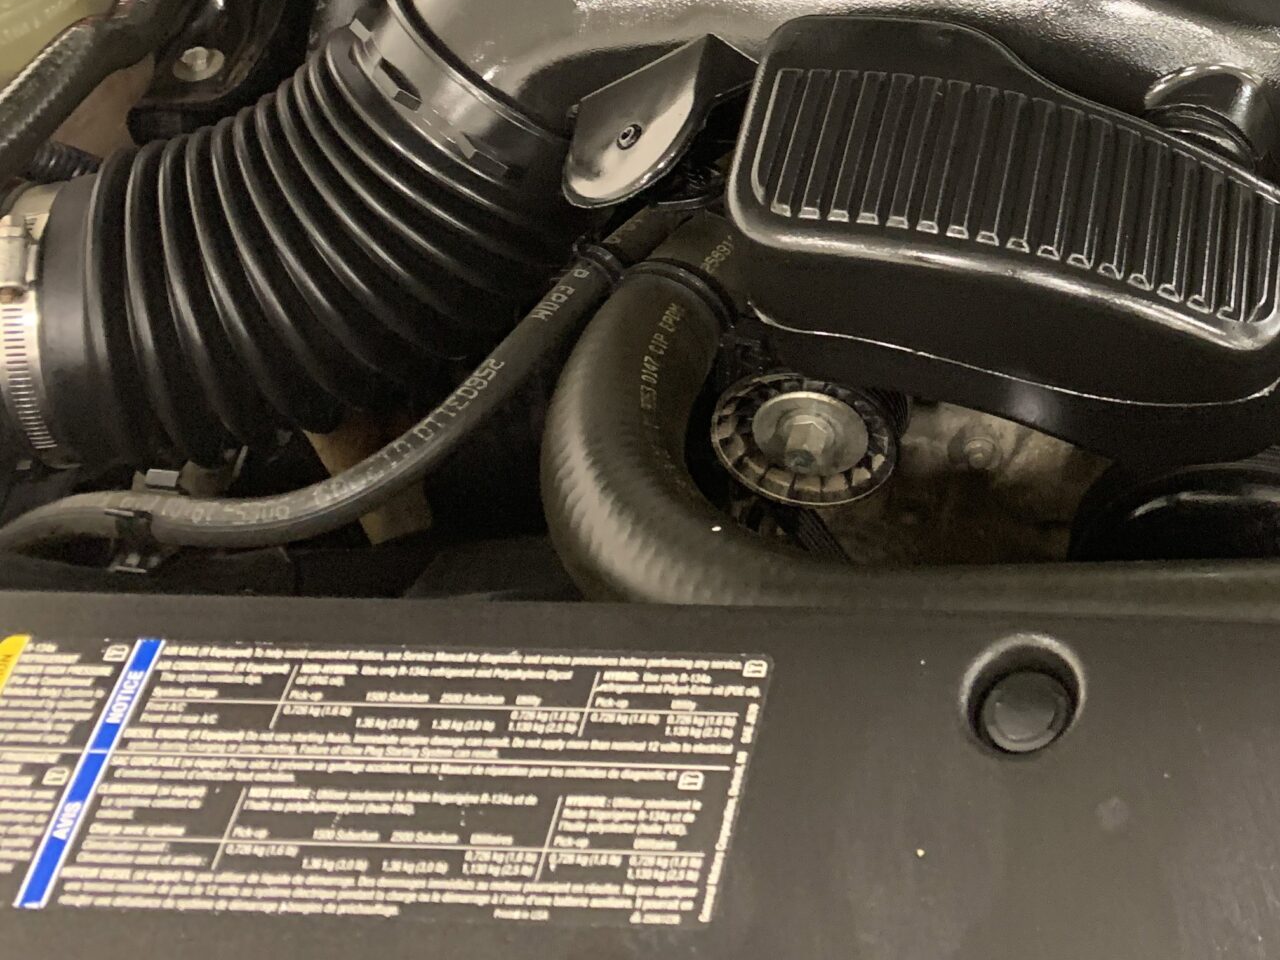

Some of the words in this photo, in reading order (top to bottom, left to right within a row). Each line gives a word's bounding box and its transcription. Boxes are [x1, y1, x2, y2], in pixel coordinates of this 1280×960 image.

[530, 284, 577, 323] EPDM
[105, 669, 146, 725] NOTICE
[52, 801, 83, 841] AVIS
